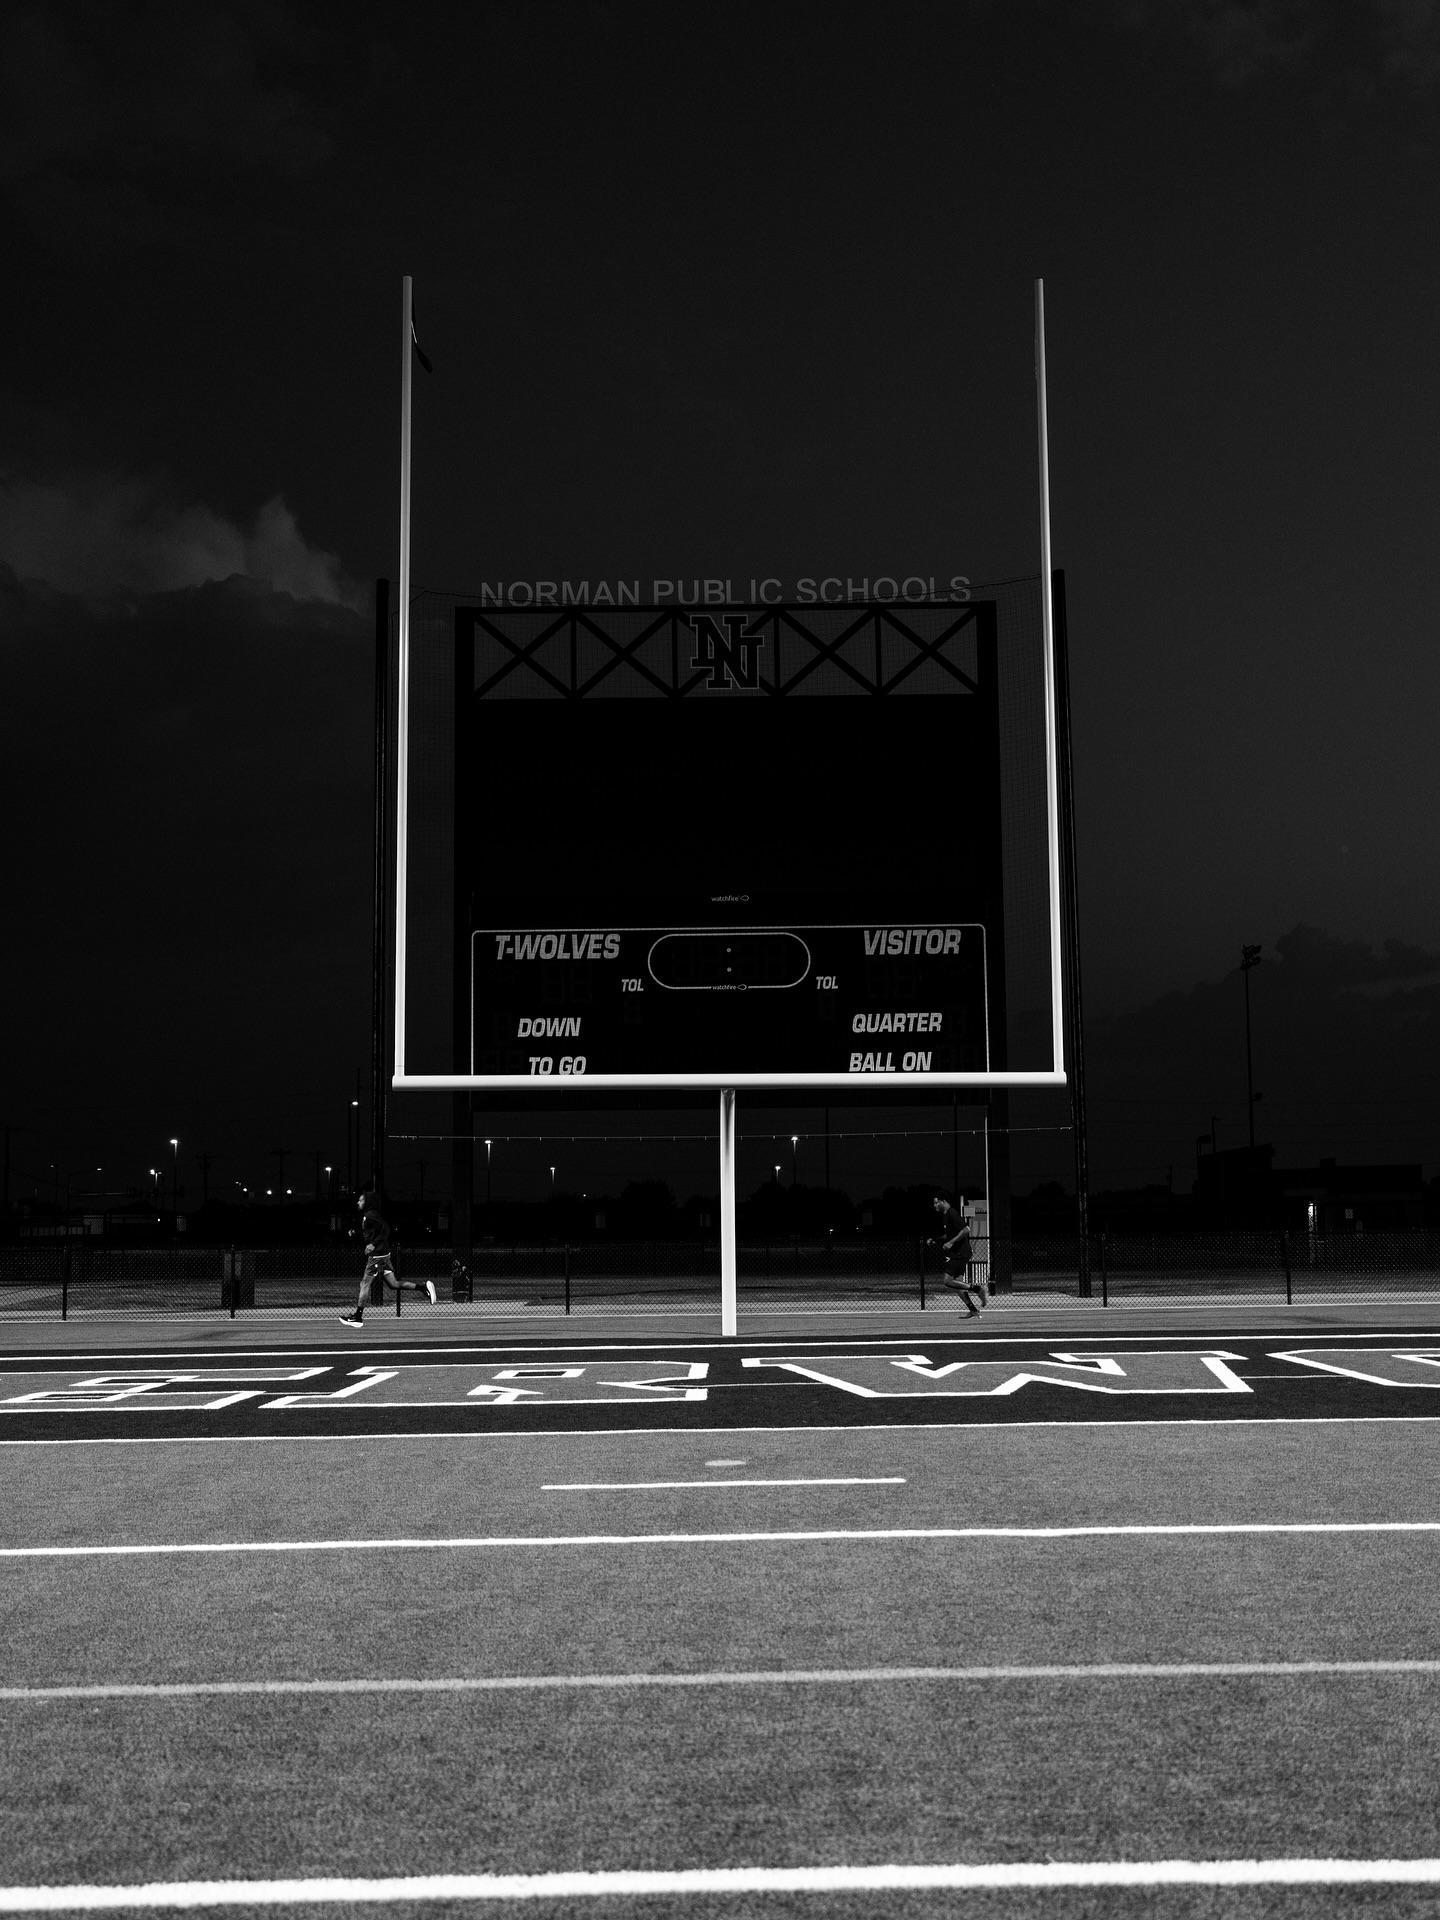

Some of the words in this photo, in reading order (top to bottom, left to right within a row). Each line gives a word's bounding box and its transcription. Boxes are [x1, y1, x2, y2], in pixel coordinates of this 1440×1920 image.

[481, 580, 640, 607] NORMAN
[653, 578, 783, 605] PUBLIC
[796, 576, 972, 604] SCHOOLS
[494, 932, 623, 961] T-WOLVES
[863, 928, 962, 957] VISITOR
[621, 978, 645, 993] TOL
[815, 976, 839, 990] TOL
[517, 1017, 582, 1038] DOWN
[851, 1012, 943, 1034] QUARTER
[528, 1056, 554, 1074] TO
[558, 1056, 587, 1074] GO
[848, 1052, 896, 1072] BALL
[902, 1052, 933, 1072] ON
